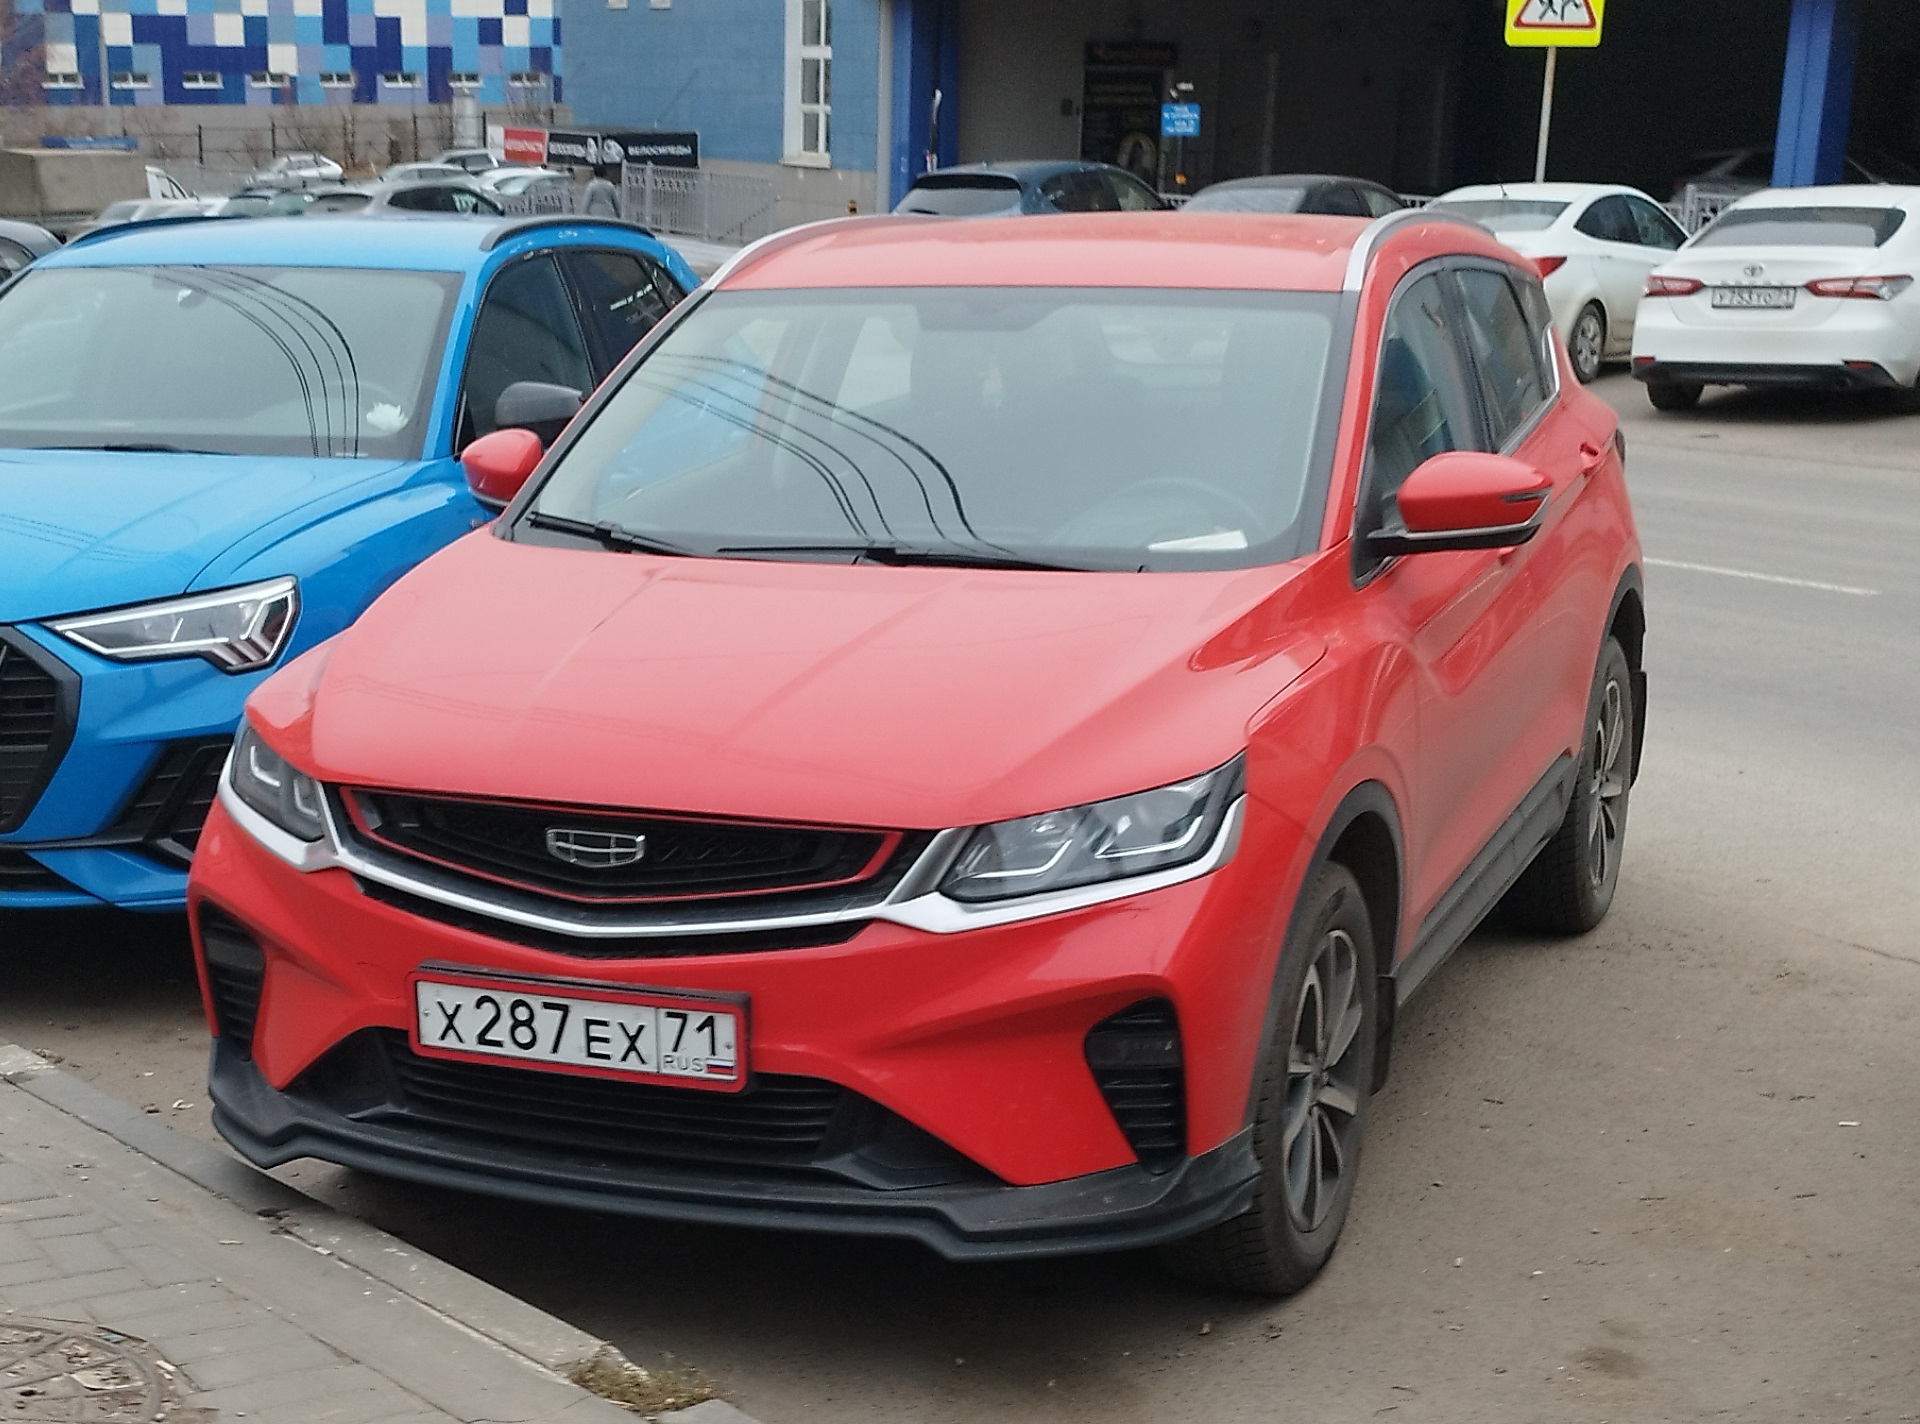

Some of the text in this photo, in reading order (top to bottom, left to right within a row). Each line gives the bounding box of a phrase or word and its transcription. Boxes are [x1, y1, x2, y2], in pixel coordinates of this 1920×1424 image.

[437, 995, 717, 1065] Х287ЕХ 71
[662, 1054, 706, 1073] RUS
